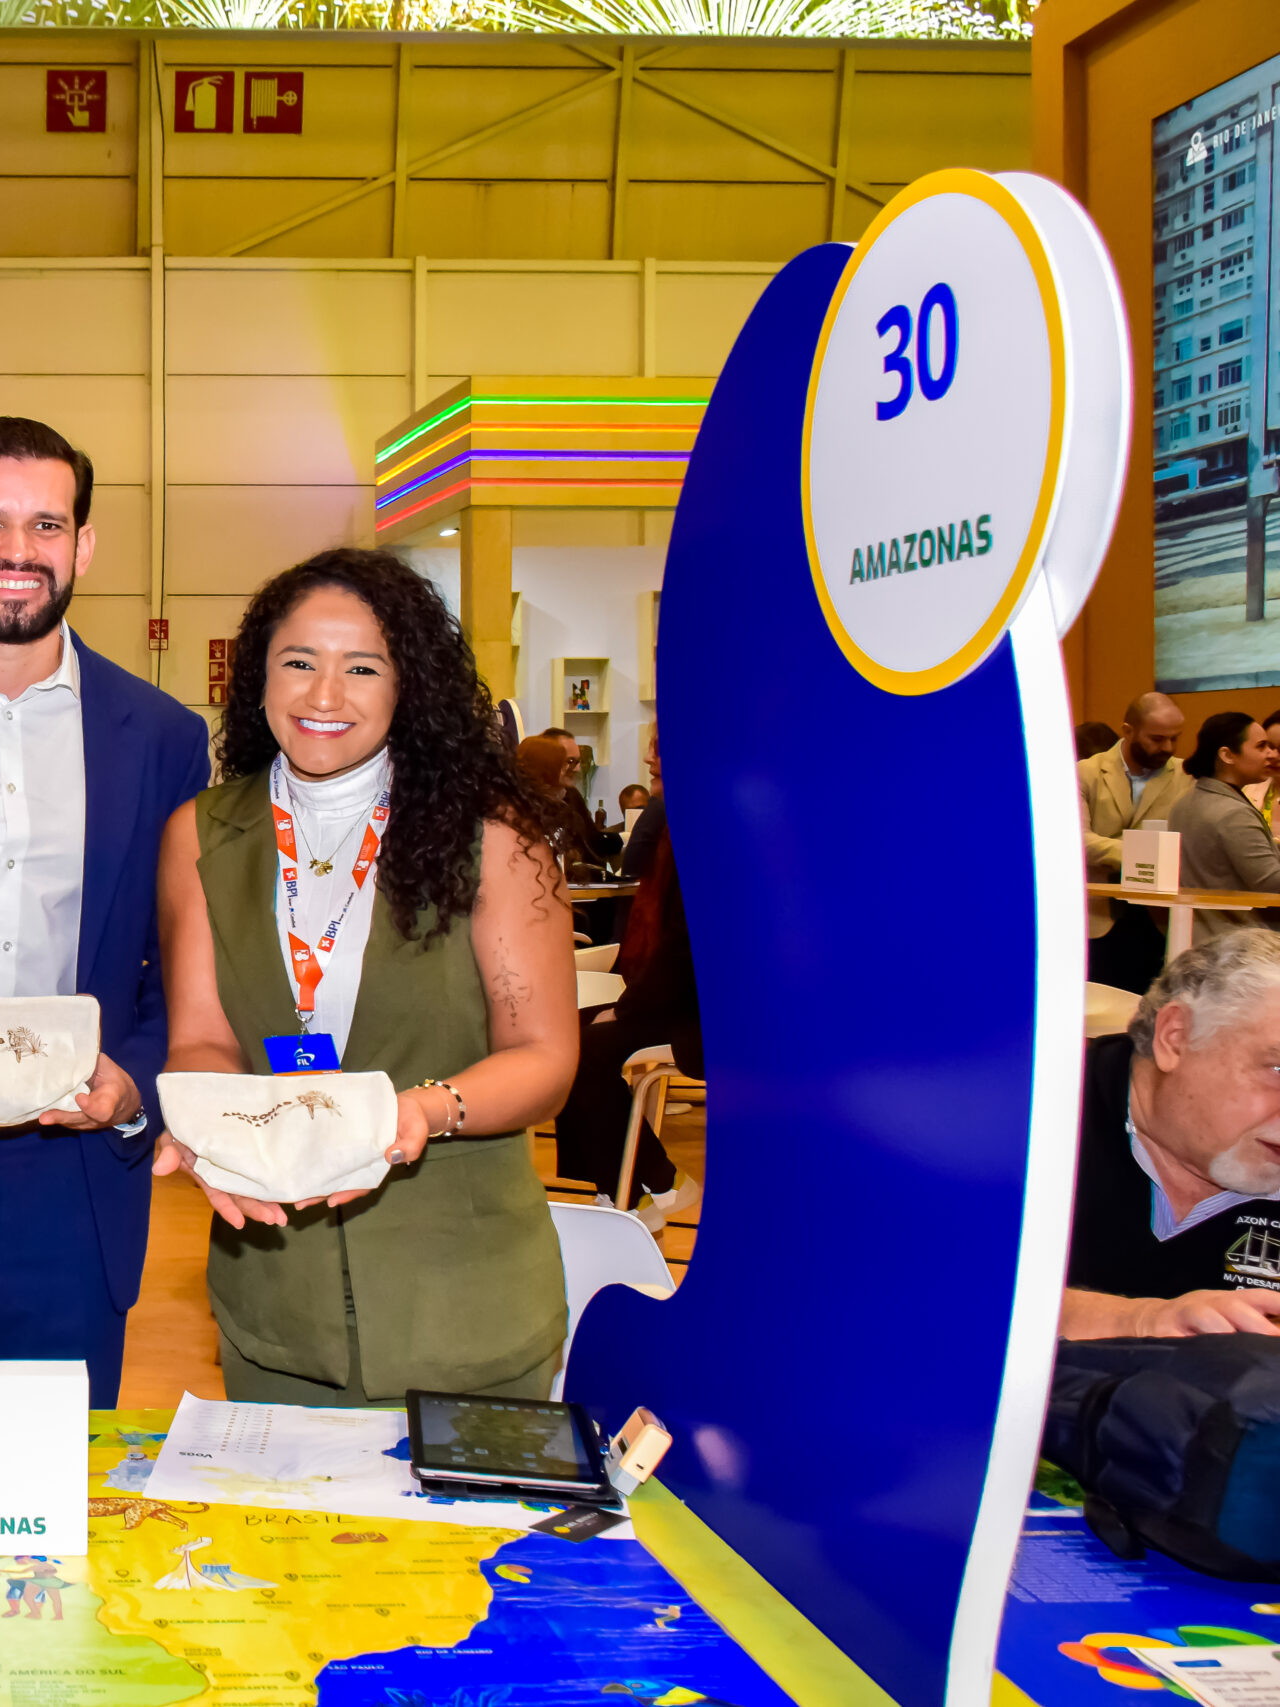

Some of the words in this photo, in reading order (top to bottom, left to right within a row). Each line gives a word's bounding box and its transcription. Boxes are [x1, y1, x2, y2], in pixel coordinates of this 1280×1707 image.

[1212, 129, 1230, 149] RIO
[1233, 121, 1247, 139] DE
[875, 282, 960, 421] 30
[849, 513, 994, 586] AMAZONAS
[286, 881, 298, 898] BPI
[324, 920, 341, 939] BPI
[297, 1058, 310, 1066] FIL
[222, 1101, 292, 1121] AMAZONAS
[1236, 1215, 1267, 1226] AZON
[1223, 1273, 1244, 1283] M/V
[245, 1514, 357, 1526] BRASIL
